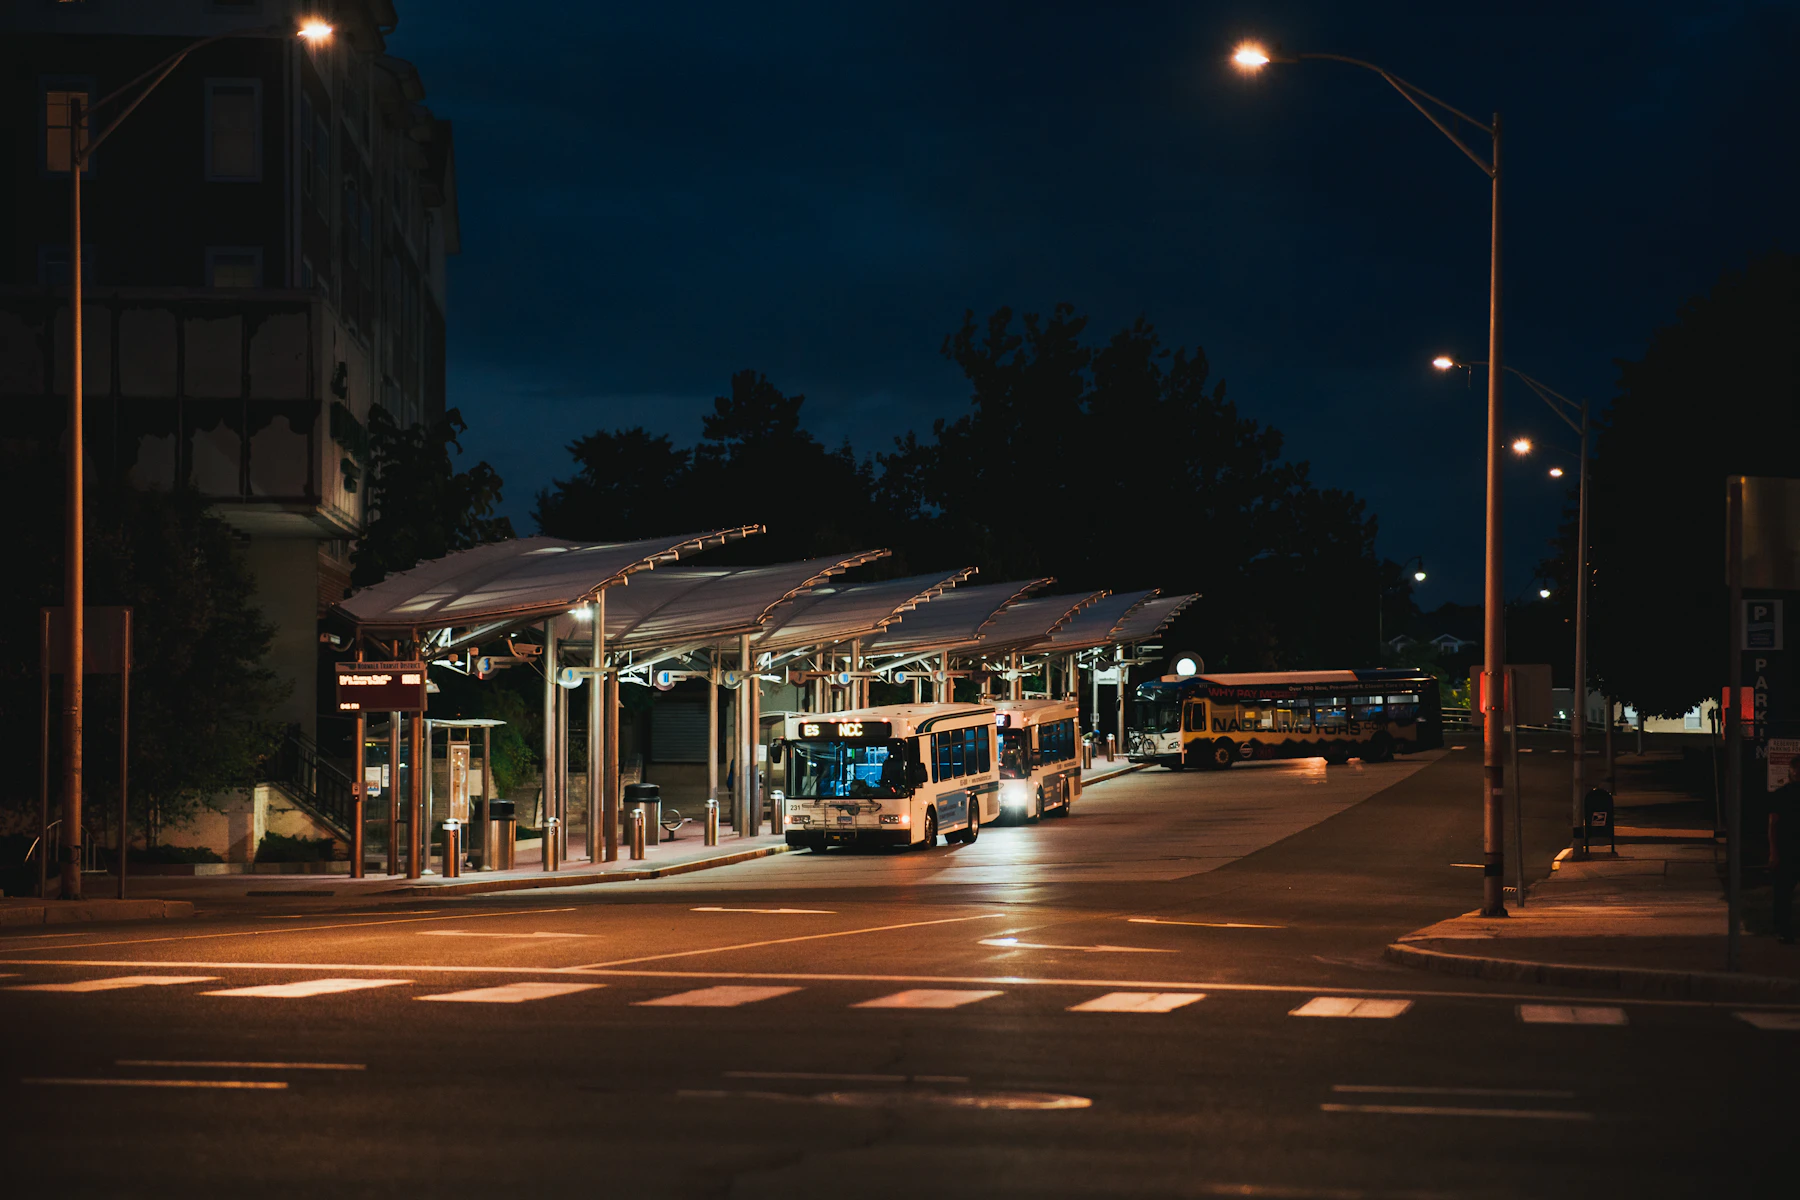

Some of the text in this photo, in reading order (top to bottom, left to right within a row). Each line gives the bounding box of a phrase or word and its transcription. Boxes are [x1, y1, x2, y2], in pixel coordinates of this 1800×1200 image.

[1754, 606, 1768, 621] P
[662, 672, 670, 683] 11
[1207, 687, 1235, 697] WHY
[1236, 688, 1258, 698] PAY
[838, 723, 863, 737] NCC
